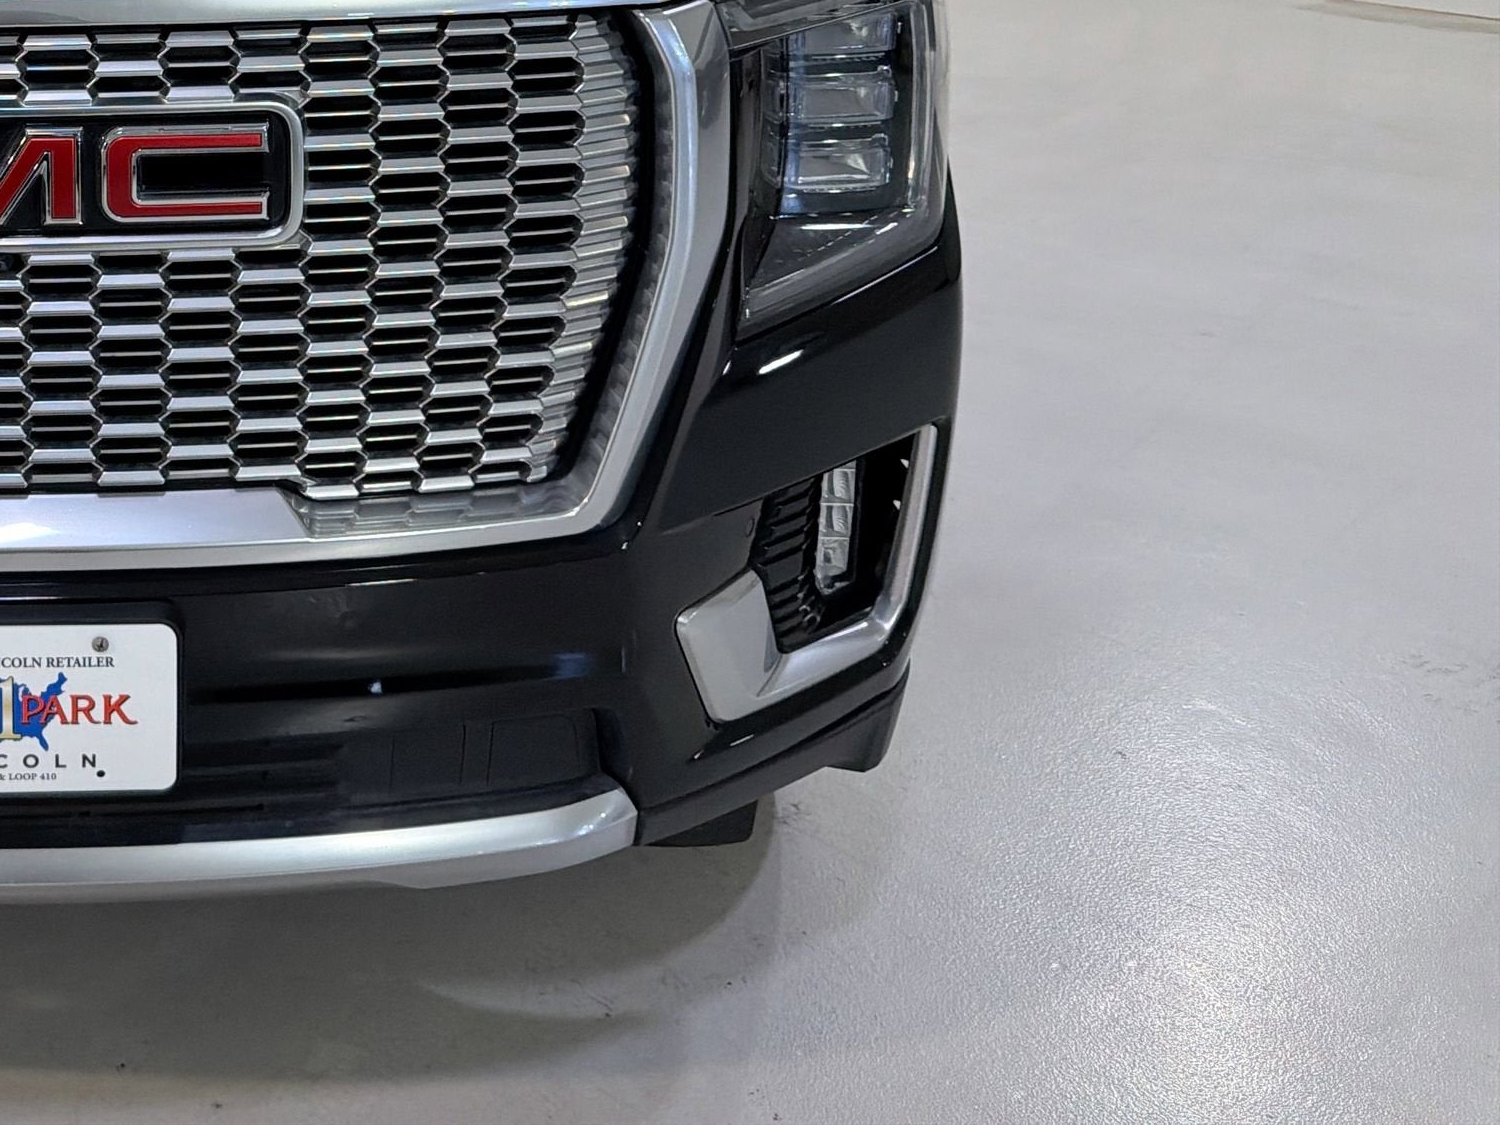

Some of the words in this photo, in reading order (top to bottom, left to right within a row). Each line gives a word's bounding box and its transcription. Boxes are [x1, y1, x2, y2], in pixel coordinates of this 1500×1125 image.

[46, 656, 115, 668] RETAILER
[21, 694, 138, 725] PARK
[8, 772, 37, 781] LOOP
[39, 772, 58, 781] 410
